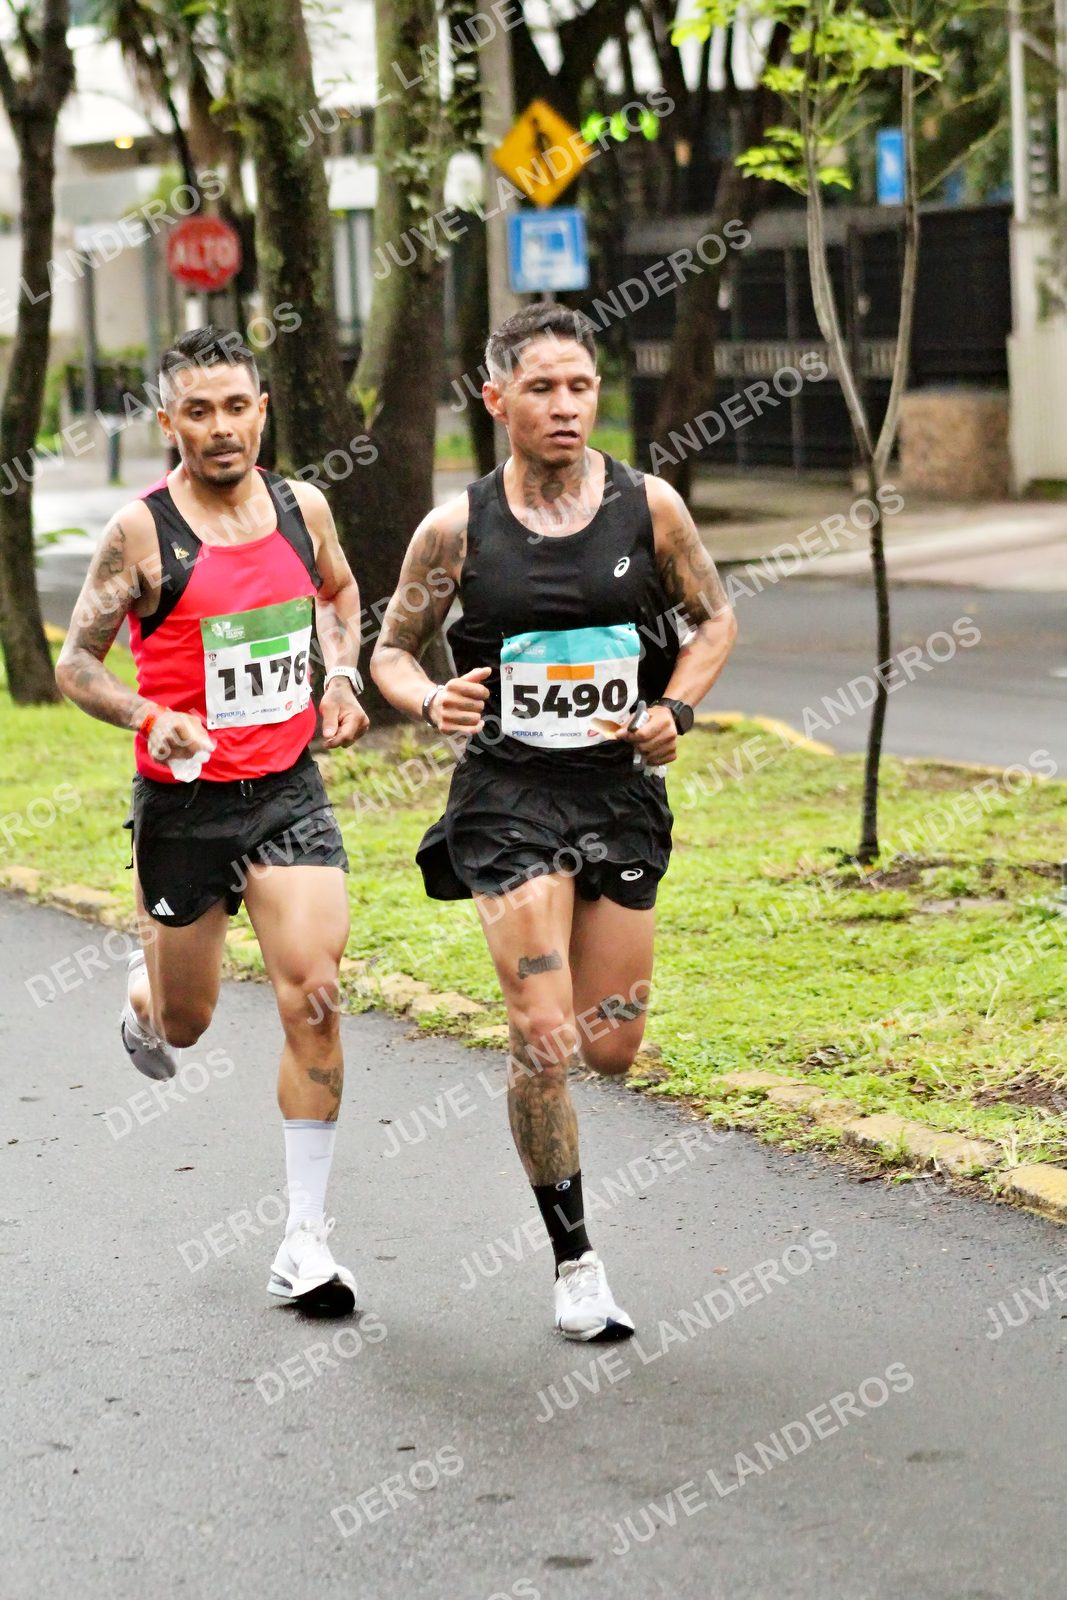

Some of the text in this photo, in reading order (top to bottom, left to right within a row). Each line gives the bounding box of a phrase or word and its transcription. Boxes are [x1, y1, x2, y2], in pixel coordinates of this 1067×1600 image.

[172, 236, 238, 270] ALTO
[217, 650, 307, 701] 1176
[511, 678, 628, 720] 5490
